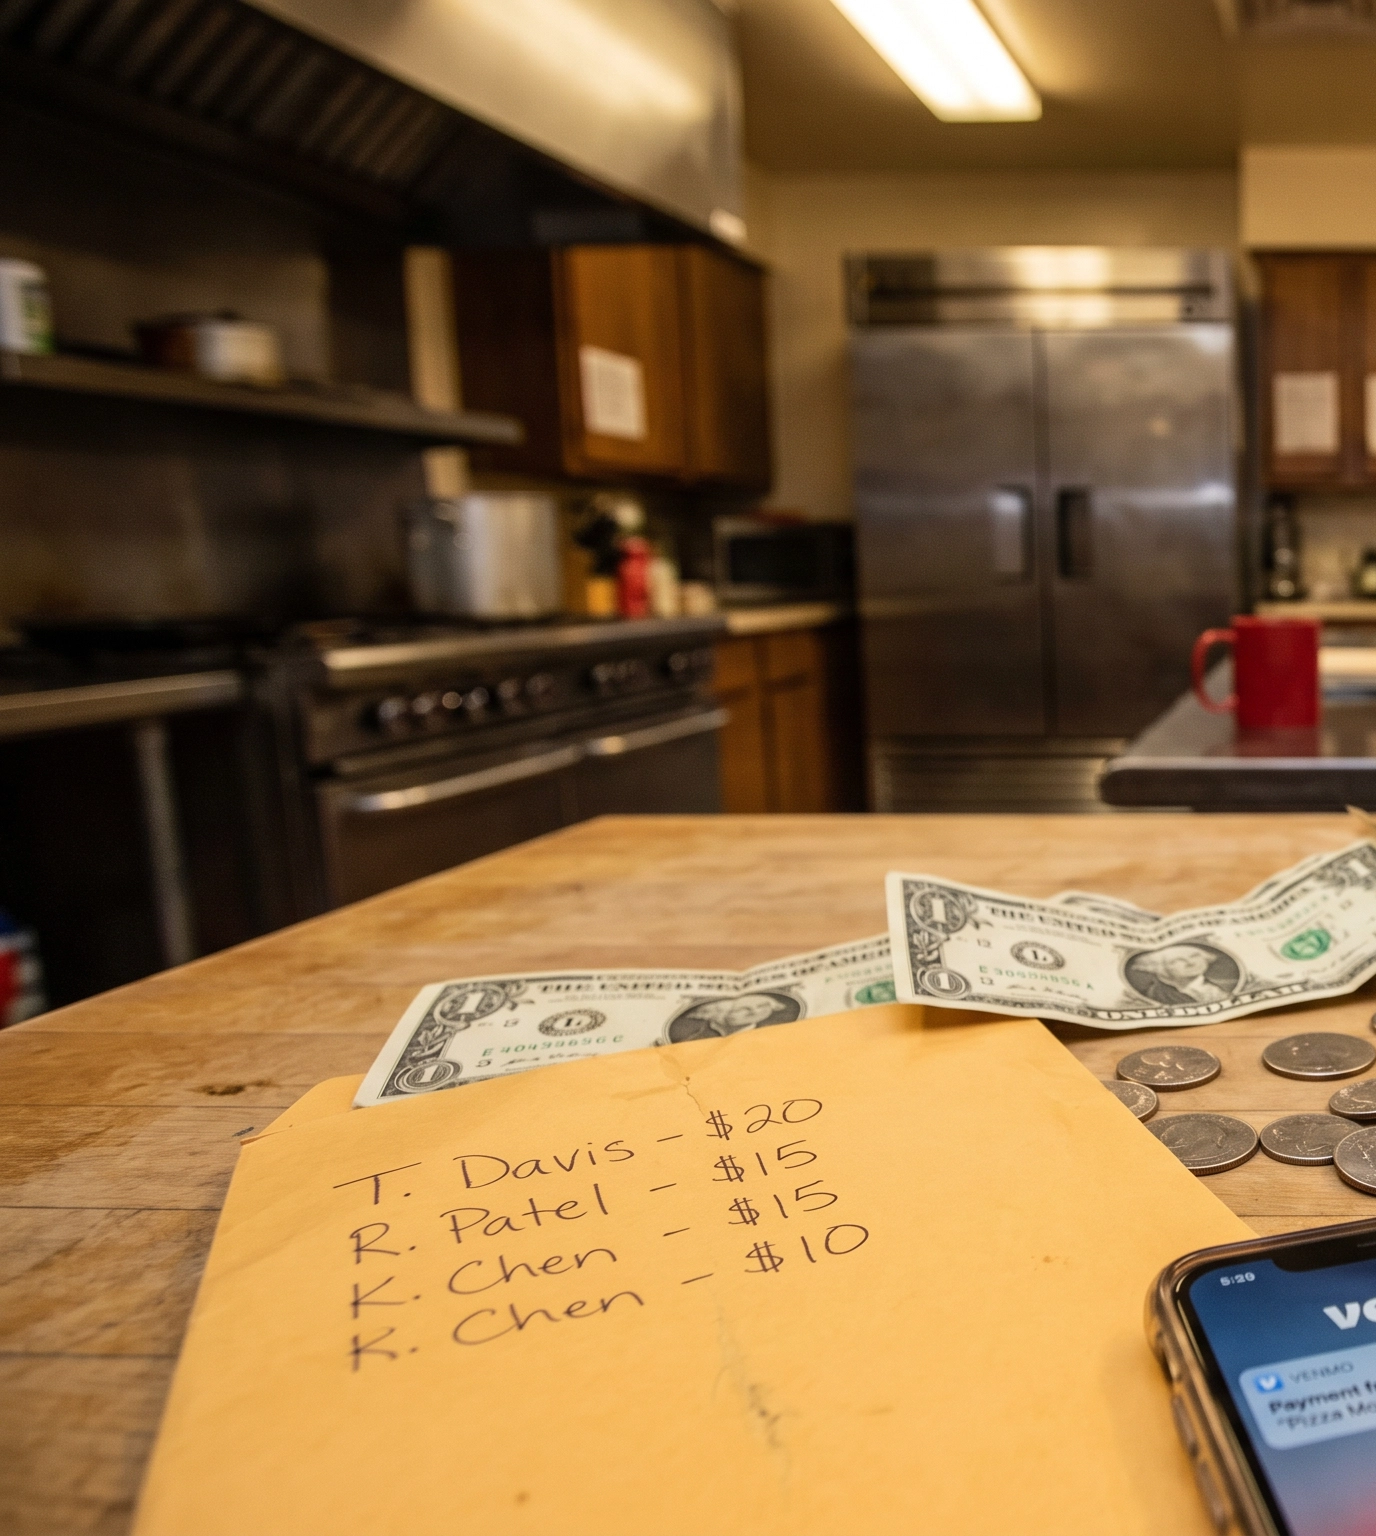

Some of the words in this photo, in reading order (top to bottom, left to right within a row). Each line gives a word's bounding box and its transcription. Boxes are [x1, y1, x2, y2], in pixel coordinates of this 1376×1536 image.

[931, 899, 947, 923] 1
[458, 991, 485, 1015] 1
[332, 1161, 423, 1206] T.
[452, 1139, 636, 1190] Davis
[704, 1097, 824, 1142] $20
[348, 1221, 418, 1265] R.
[439, 1182, 610, 1244] Patel
[711, 1139, 818, 1184] $15
[350, 1274, 422, 1320] K.
[447, 1247, 618, 1295] Chen
[727, 1179, 839, 1226] $15
[347, 1326, 420, 1373] K.
[451, 1290, 646, 1346] Chen
[743, 1222, 870, 1273] $10
[1268, 1383, 1361, 1416] Payment
[1288, 1360, 1355, 1385] VENMO
